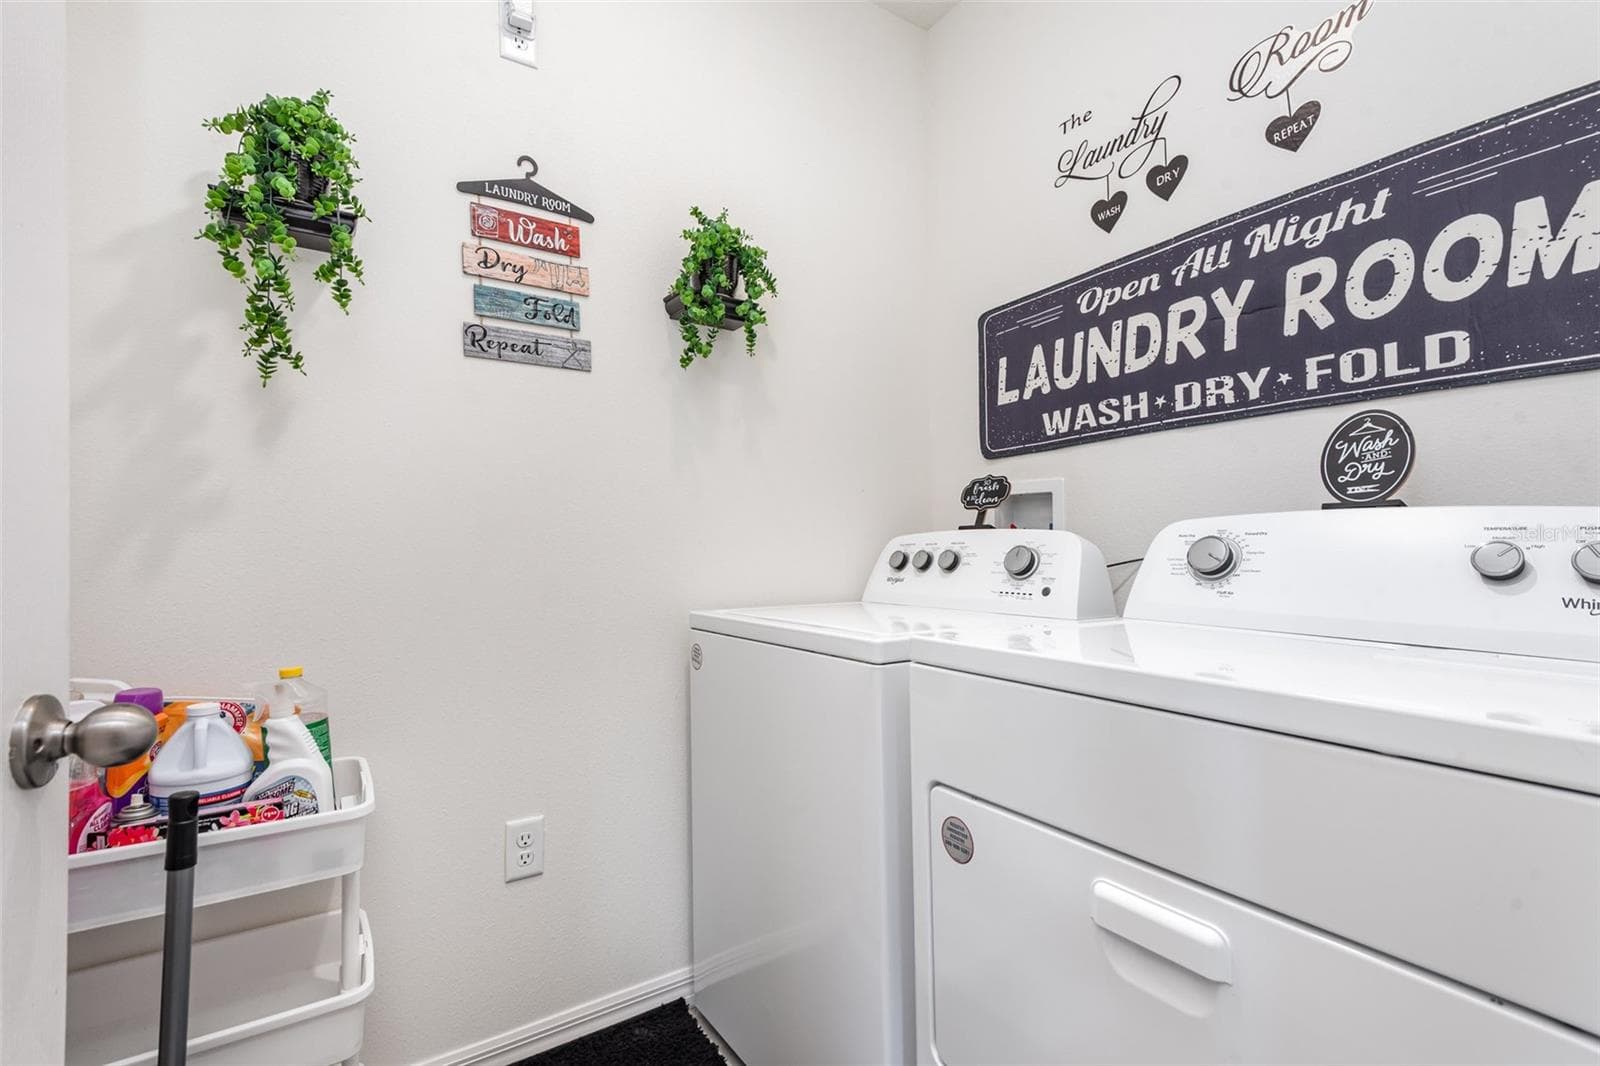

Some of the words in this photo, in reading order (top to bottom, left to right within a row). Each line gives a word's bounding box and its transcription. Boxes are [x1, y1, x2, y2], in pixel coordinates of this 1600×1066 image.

[1226, 0, 1374, 101] Room
[1054, 75, 1181, 188] Laundry
[1058, 108, 1093, 136] The
[1273, 114, 1315, 144] REPEAT
[1156, 167, 1181, 187] DRY
[485, 182, 539, 206] LAUNDRY
[542, 196, 571, 213] ROOM
[1097, 204, 1122, 223] WASH
[507, 217, 570, 251] Wash
[475, 246, 529, 284] Dry
[1076, 273, 1161, 316] Open
[1171, 239, 1231, 286] All
[1243, 188, 1392, 260] Night
[997, 279, 1255, 406] LAUNDRY
[1283, 179, 1600, 337] ROOM
[523, 296, 577, 328] Fold
[464, 324, 552, 359] Repeat
[1042, 391, 1149, 436] WASH
[1174, 366, 1271, 412] DRY
[1305, 330, 1471, 391] FOLD
[1335, 429, 1400, 464] Wash
[1365, 450, 1389, 461] AND
[1337, 461, 1396, 483] Dry
